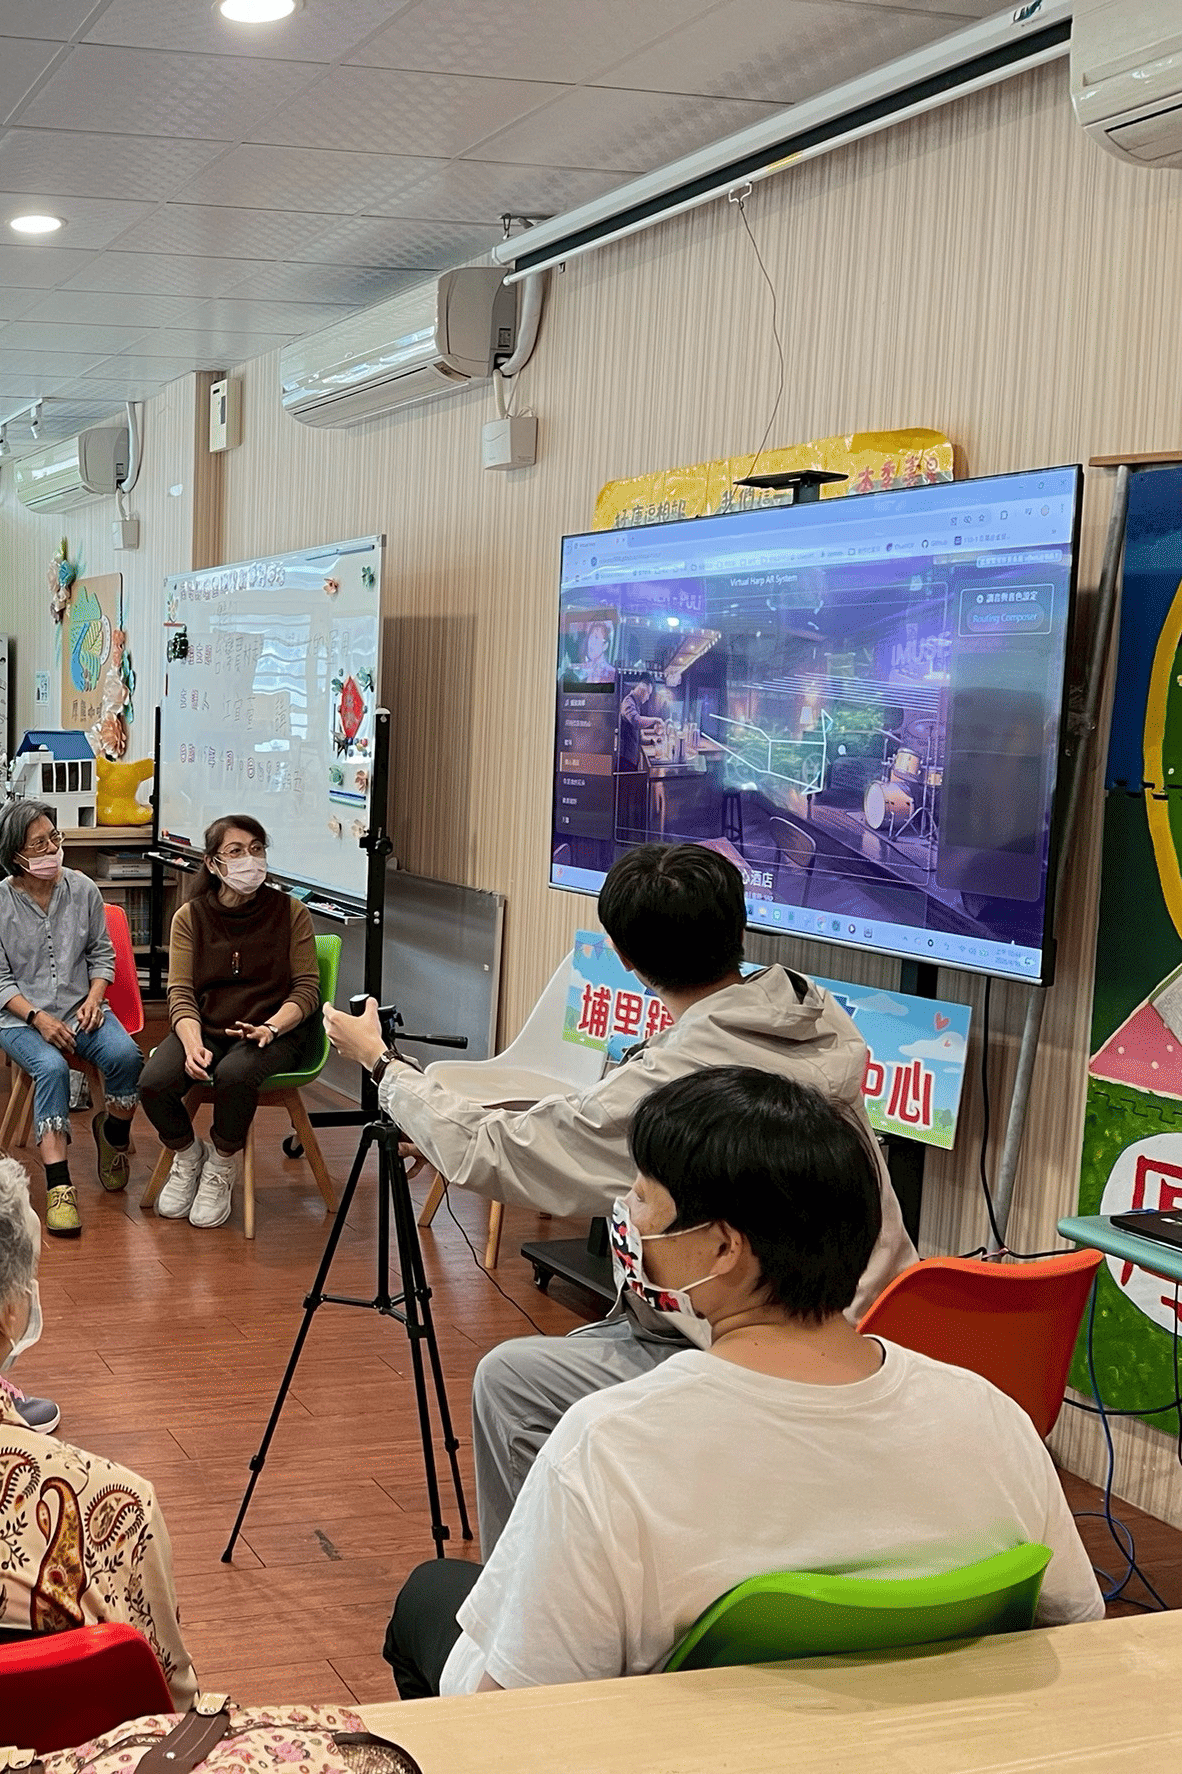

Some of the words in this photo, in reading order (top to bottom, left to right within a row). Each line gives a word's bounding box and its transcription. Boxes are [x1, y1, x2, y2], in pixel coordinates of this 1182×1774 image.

[730, 576, 749, 587] Virtual
[750, 576, 765, 587] Harp
[766, 575, 775, 584] AR
[776, 574, 798, 585] System
[972, 613, 1001, 627] Routing
[1001, 611, 1038, 625] Composer
[861, 1049, 933, 1127] 中心
